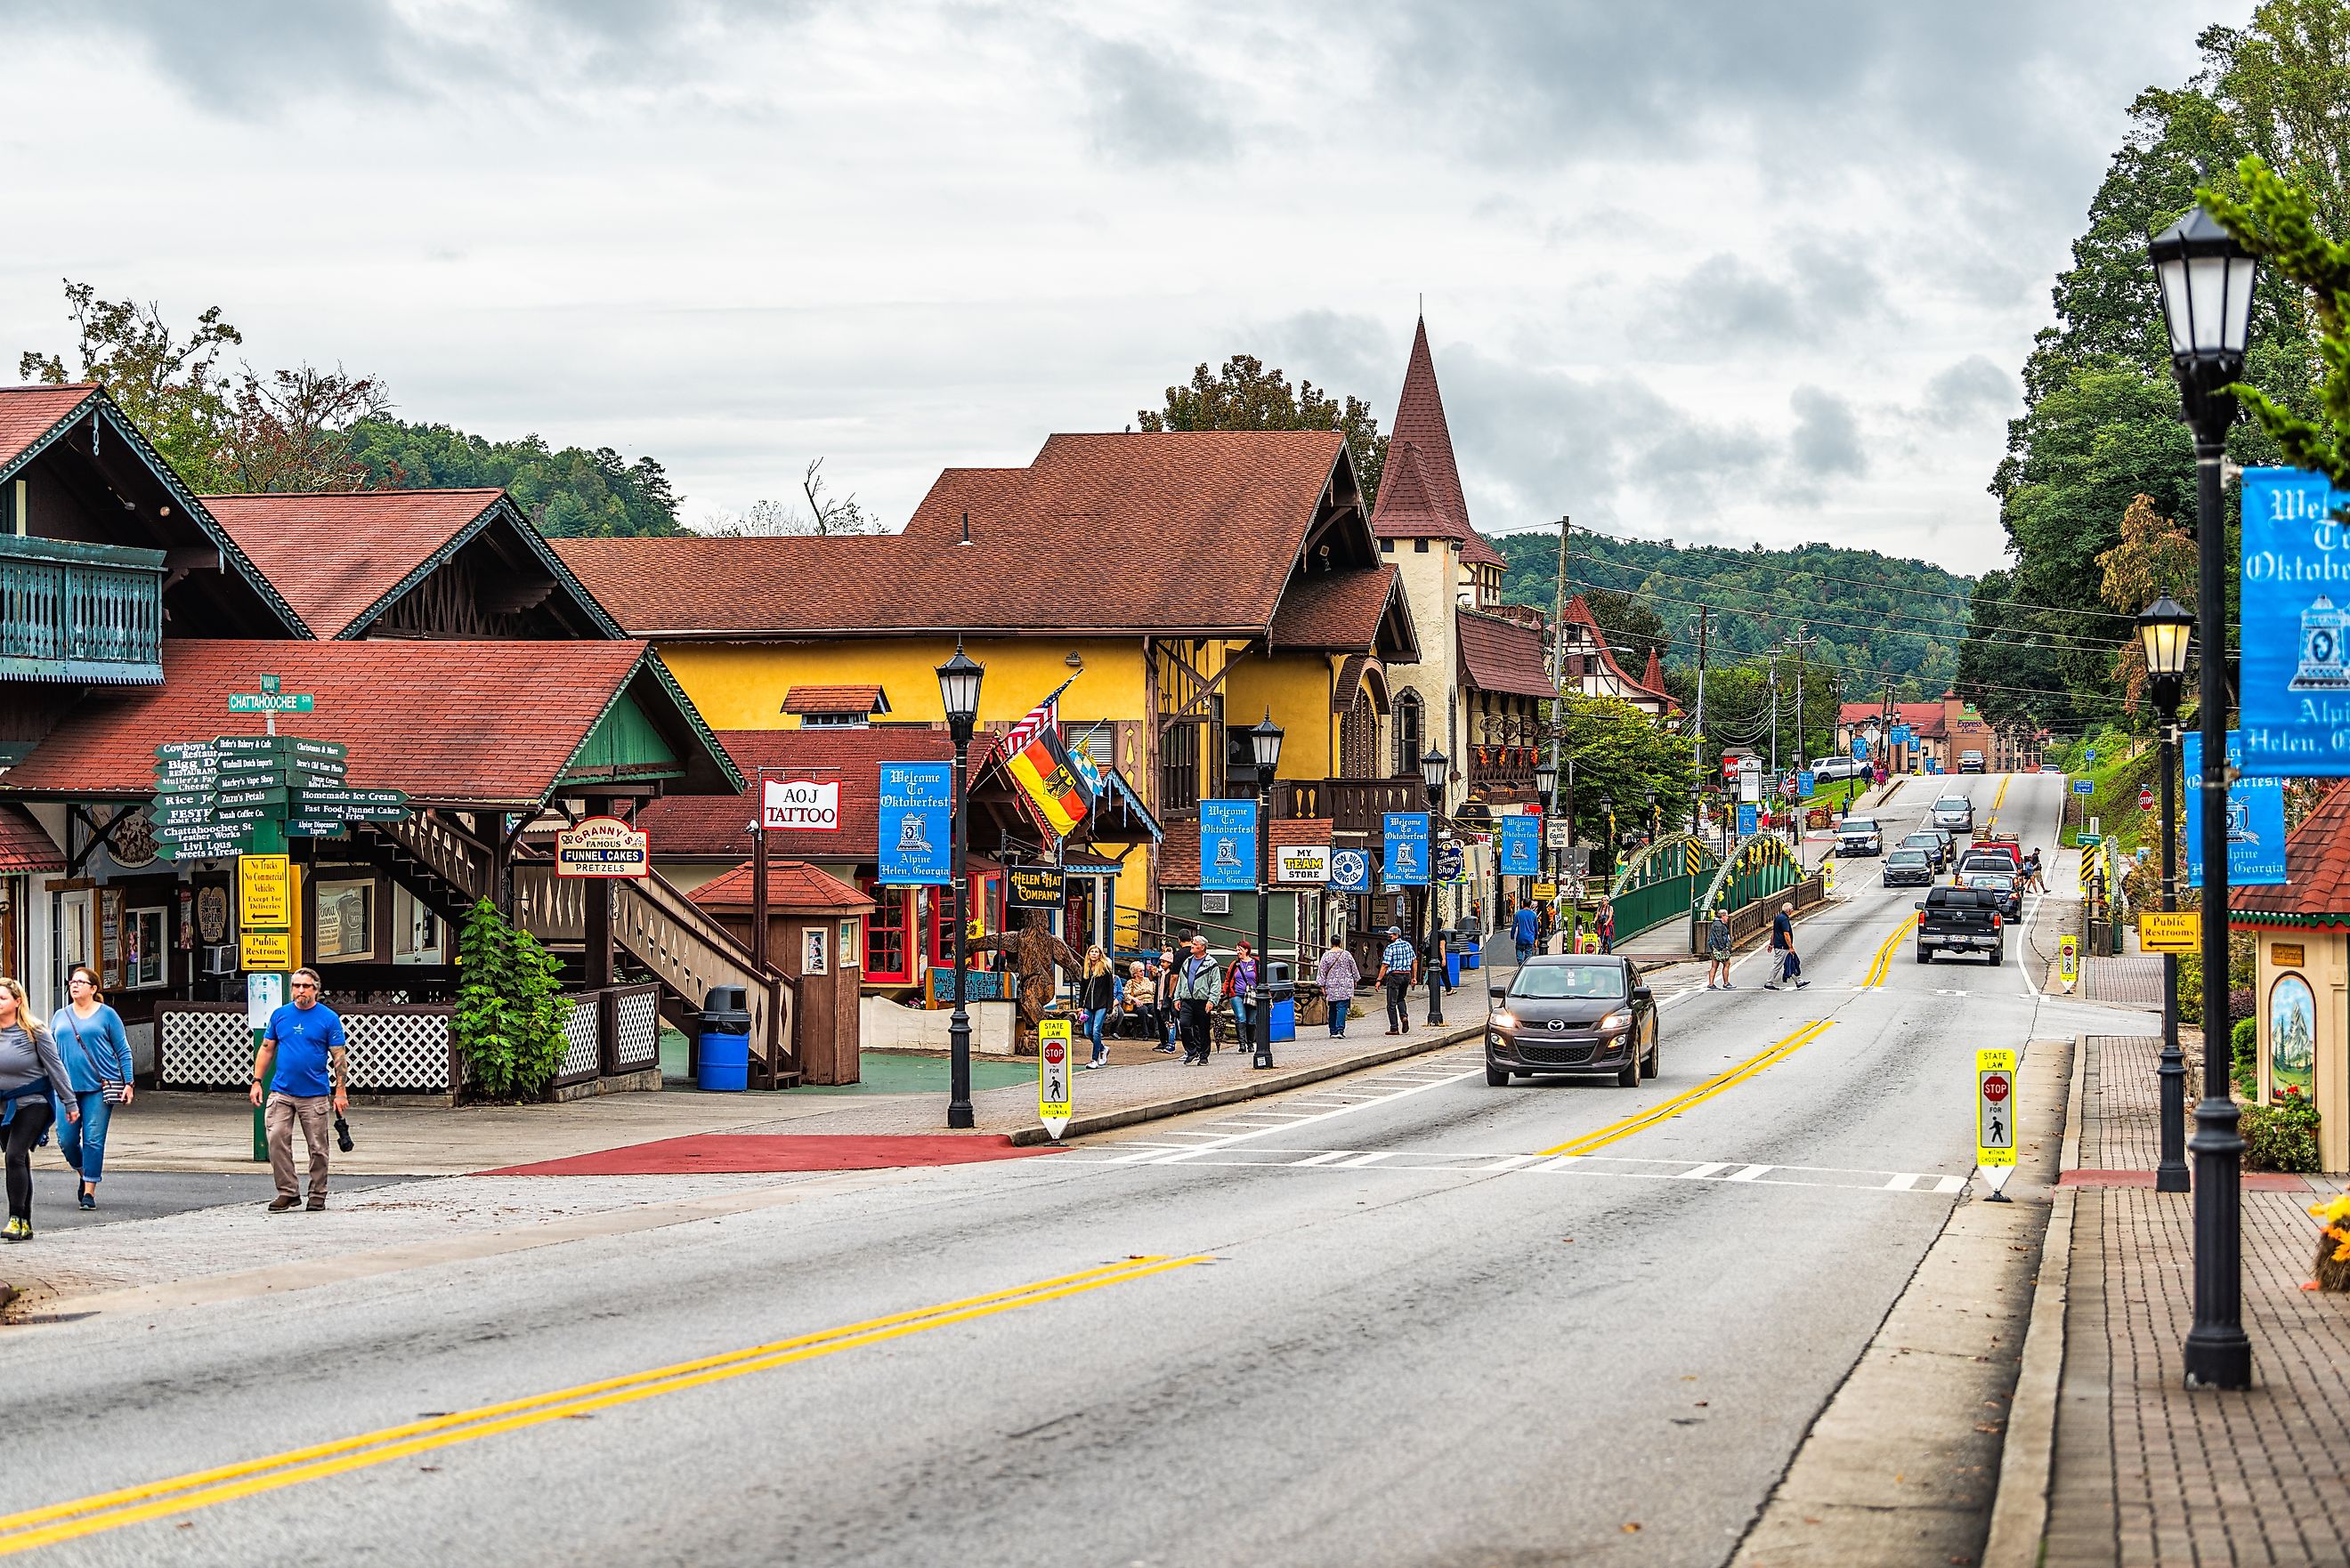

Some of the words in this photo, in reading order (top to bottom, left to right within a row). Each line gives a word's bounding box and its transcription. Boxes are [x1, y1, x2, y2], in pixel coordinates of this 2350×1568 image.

[2268, 486, 2336, 525] Wel
[2246, 551, 2350, 581] Oktobe
[231, 695, 297, 708] CHATTAHOOCHEE
[2300, 699, 2350, 728] Alpi
[1957, 720, 1982, 729] Express
[220, 740, 237, 748] Hofer's
[238, 740, 255, 749] Bakery
[261, 740, 272, 748] Cafe
[2249, 729, 2322, 754] Helen,
[164, 742, 207, 753] Cowboys
[296, 742, 320, 753] Christmas
[327, 746, 339, 755] More
[167, 759, 198, 771] Bigg
[311, 760, 319, 769] Old
[320, 762, 330, 771] Time
[331, 763, 344, 773] Photo
[222, 778, 245, 788] Marley's
[260, 775, 274, 784] Shop
[890, 770, 941, 784] Welcome
[178, 783, 210, 791] Cheese
[906, 782, 924, 796] To
[165, 796, 194, 805] Rice
[199, 794, 214, 804] Je
[222, 793, 243, 804] Zuzu's
[245, 791, 265, 801] Petals
[302, 791, 350, 800] Homemade
[353, 792, 366, 800] Ice
[369, 792, 397, 801] Cream
[783, 788, 819, 804] AOJ
[880, 794, 948, 808] Oktoberfest
[2139, 796, 2152, 805] STOP
[237, 809, 254, 818] Coffee
[255, 809, 264, 817] Co.
[304, 804, 320, 812] Fast
[323, 804, 344, 813] Food,
[347, 805, 374, 814] Funnel
[377, 806, 401, 815] Cakes
[766, 806, 836, 823] TATTOO
[1208, 805, 1248, 818] Welcome
[298, 820, 312, 828] Alpine
[313, 820, 339, 829] Dispensary
[1221, 814, 1235, 825] To
[1390, 817, 1422, 826] Welcome
[164, 823, 239, 837] Chattahoochee
[241, 822, 255, 831] St.
[1201, 823, 1254, 834] Oktoberfest
[1400, 825, 1412, 833] To
[1502, 830, 1538, 838] Oktoberfest
[178, 831, 211, 842] Leather
[215, 830, 241, 839] Works
[575, 826, 632, 845] GRANNY'S
[1384, 832, 1427, 840] Oktoberfest
[183, 841, 203, 852] Livi
[207, 840, 232, 850] Lous
[174, 849, 207, 860] Sweets
[213, 847, 244, 856] Treats
[566, 851, 604, 861] FUNNEL
[606, 851, 639, 861] CAKES
[1297, 849, 1312, 857] MY
[2229, 847, 2258, 861] lpine
[251, 861, 259, 869] No
[261, 861, 278, 869] Trucks
[899, 853, 931, 866] Alpine
[1284, 857, 1323, 870] TEAM
[1335, 853, 1348, 866] COOL
[1349, 853, 1362, 870] RIVER
[575, 863, 625, 872] PRETZELS
[881, 864, 911, 877] Helen,
[912, 865, 950, 878] Georgia
[1217, 867, 1241, 877] Alpine
[1438, 865, 1455, 875] Shop
[2234, 861, 2284, 876] Georgia
[245, 872, 253, 881] No
[254, 872, 284, 881] Commercial
[1288, 870, 1319, 878] STORE
[1333, 866, 1349, 883] TUBING
[1405, 873, 1428, 881] Georgia
[1202, 876, 1225, 885] Helen,
[1227, 876, 1255, 885] Georgia
[254, 884, 275, 893] Vehicles
[248, 895, 269, 903] Except
[2153, 917, 2185, 926] Public
[2145, 928, 2194, 936] Restrooms
[253, 937, 279, 946] Public
[246, 947, 286, 955] Restrooms
[1045, 1048, 1064, 1057] STOP
[1983, 1052, 2007, 1060] STATE
[1984, 1084, 2007, 1094] STOP
